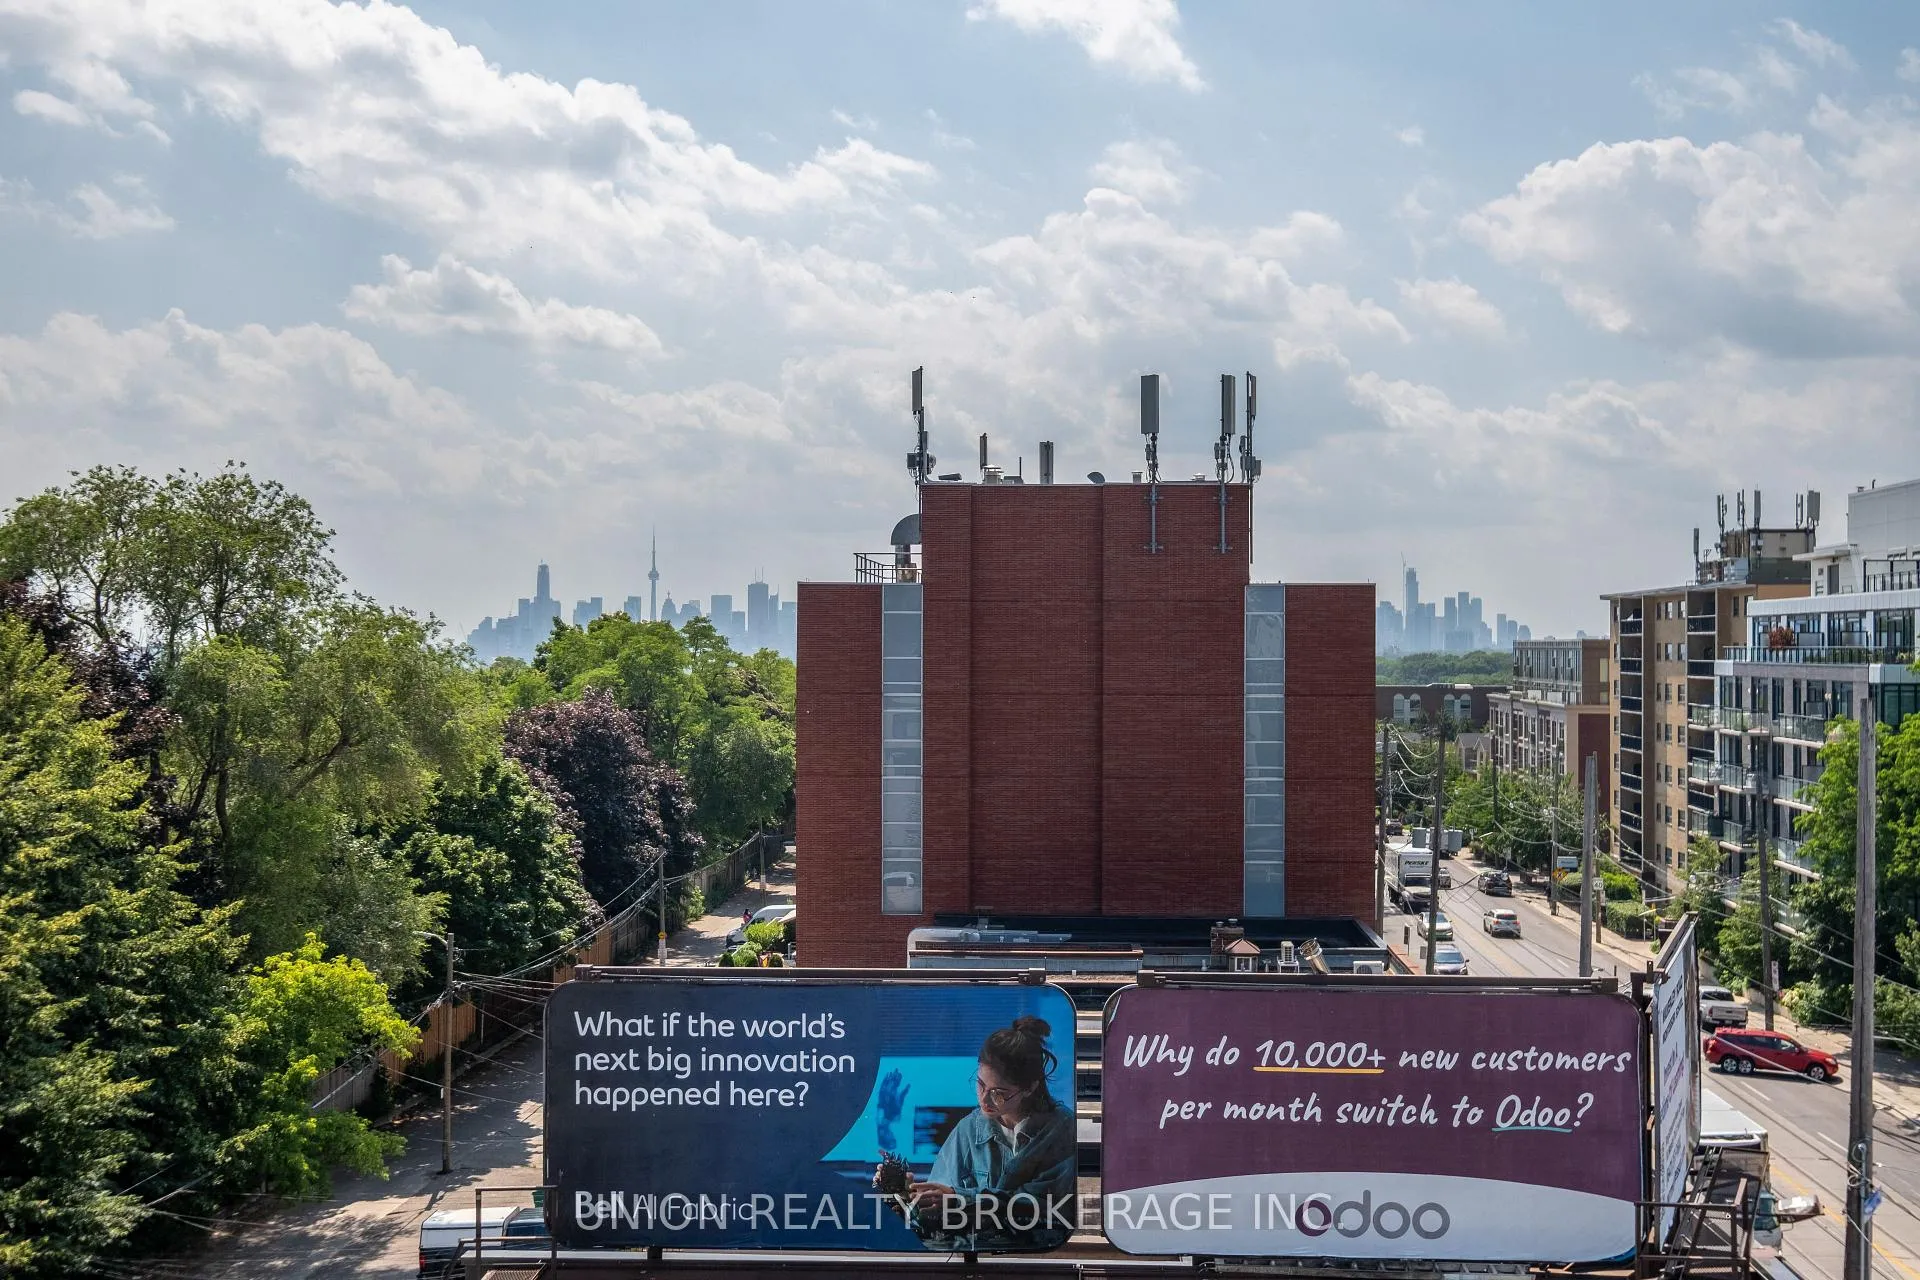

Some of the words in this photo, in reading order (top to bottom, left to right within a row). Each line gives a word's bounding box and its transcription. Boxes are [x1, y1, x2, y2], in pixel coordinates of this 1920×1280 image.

[574, 1012, 655, 1038] What
[663, 1012, 681, 1037] if
[688, 1013, 734, 1038] the
[575, 1050, 639, 1072] next
[647, 1047, 691, 1079] big
[701, 1047, 855, 1073] innovation
[1124, 1034, 1194, 1076] Why
[1206, 1036, 1240, 1065] do
[1257, 1040, 1385, 1071] 10,000+
[1399, 1047, 1458, 1070] new
[1471, 1045, 1632, 1073] customers
[575, 1080, 721, 1112] happened
[729, 1081, 809, 1107] here?
[1160, 1098, 1211, 1129] per
[1223, 1093, 1322, 1123] month
[1336, 1094, 1438, 1126] switch
[1452, 1095, 1482, 1127] to
[1495, 1093, 1594, 1128] Odoo?
[575, 1191, 624, 1218] Bell
[668, 1195, 753, 1220] Fabric
[1295, 1189, 1450, 1239] odoo
